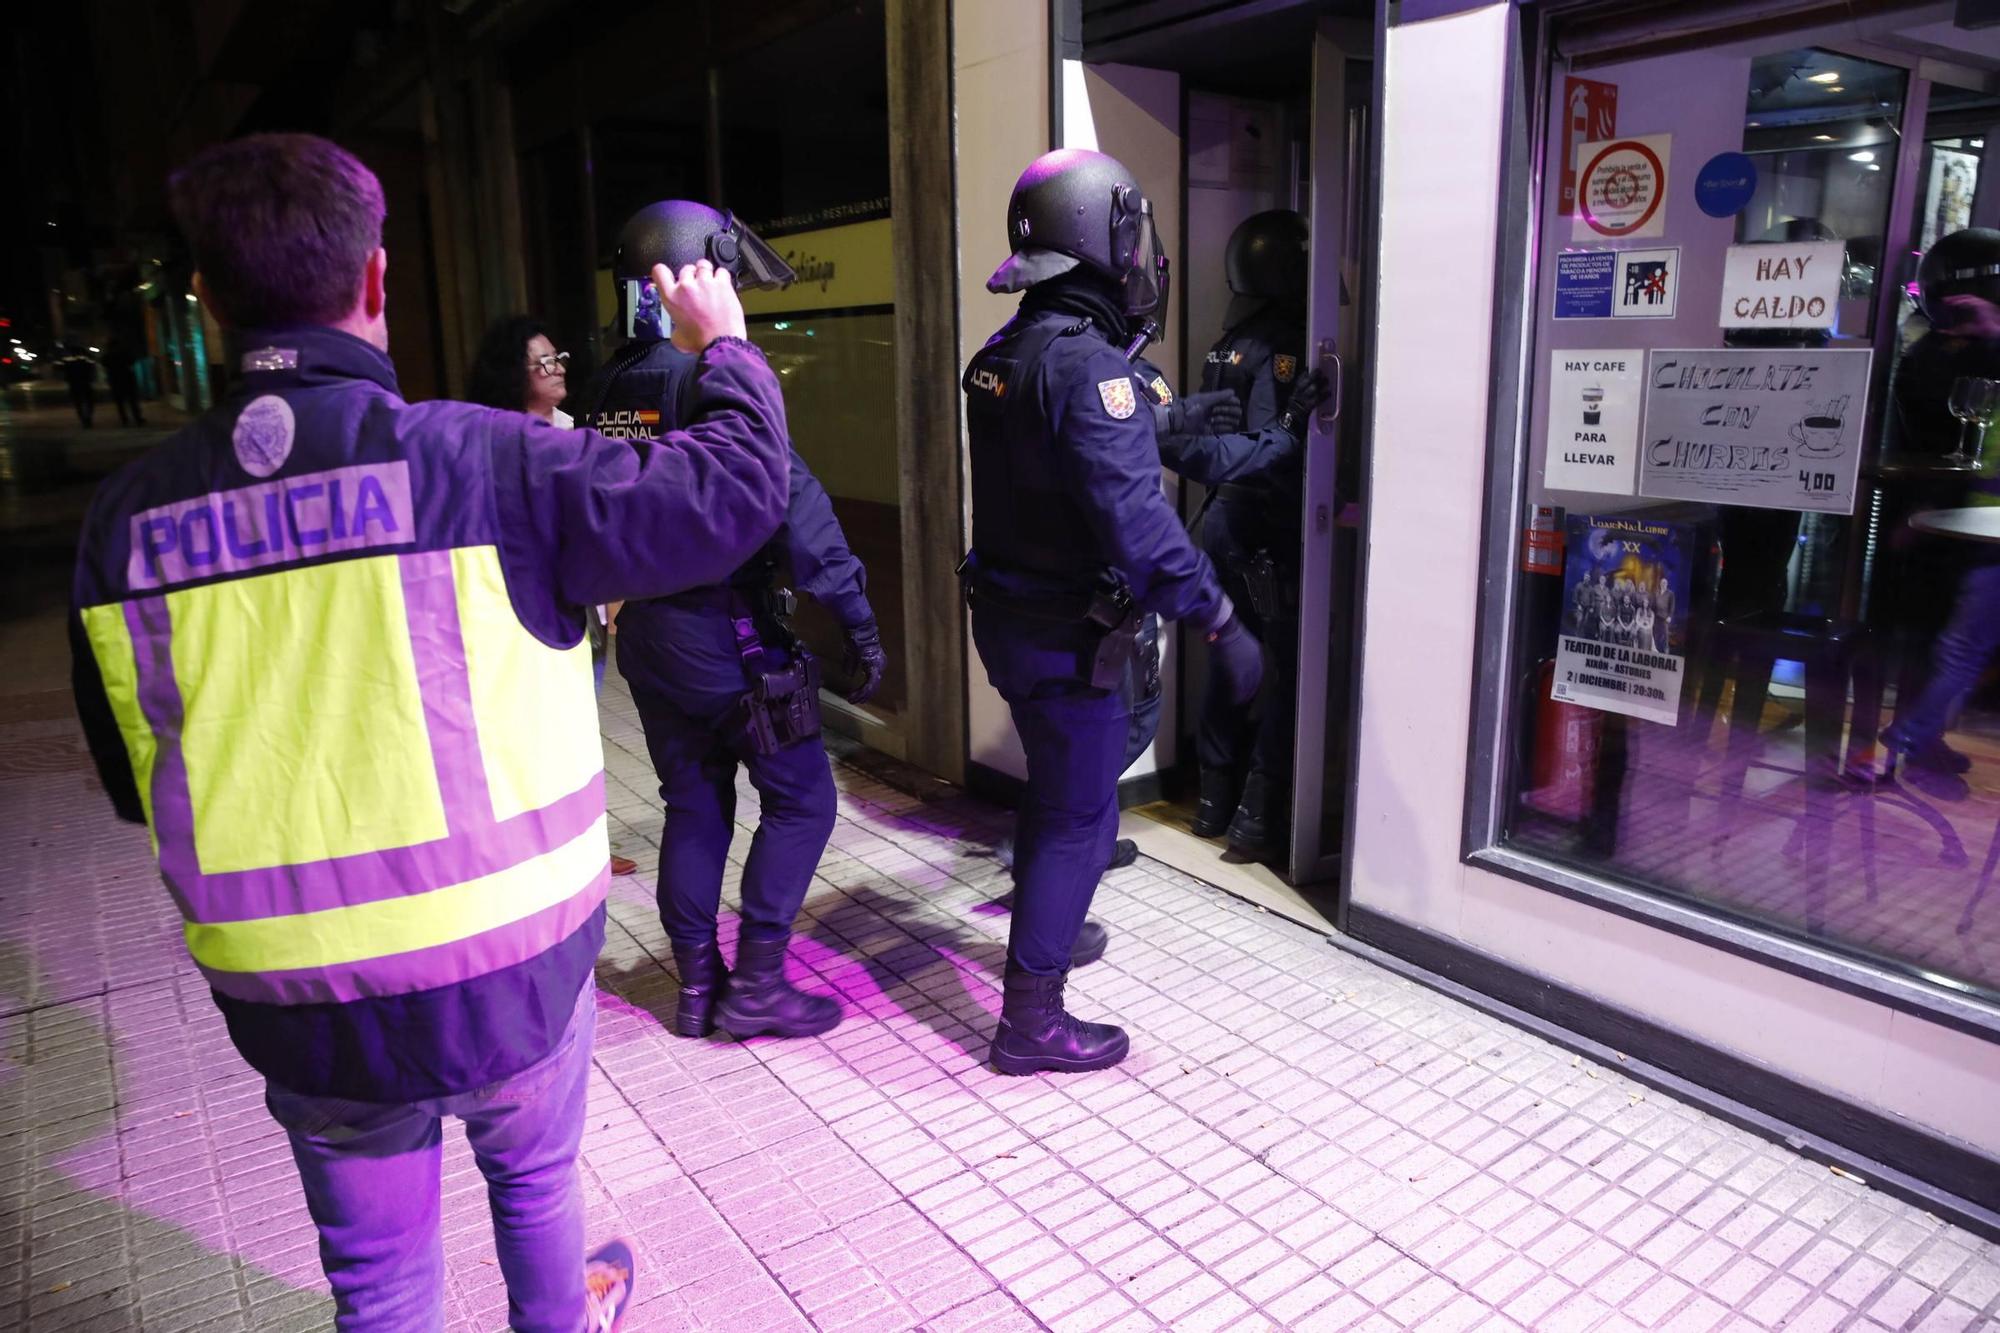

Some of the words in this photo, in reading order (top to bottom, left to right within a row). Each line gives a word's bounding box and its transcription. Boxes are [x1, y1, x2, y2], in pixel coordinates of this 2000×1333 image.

[1756, 254, 1814, 282] HAY
[1734, 295, 1826, 320] CALDO
[1565, 361, 1590, 372] HAY
[1593, 361, 1626, 372] CAFE
[1651, 359, 1820, 392] CHOCOLATE
[1699, 400, 1760, 430] CON
[1574, 432, 1607, 444] PARA
[1563, 452, 1615, 467] LLEVAR
[1646, 434, 1791, 473] CHURROS
[141, 474, 400, 580] POLICIA
[1622, 540, 1641, 554] XX
[1564, 639, 1602, 657] TEATRO
[1603, 646, 1617, 660] DE
[1618, 648, 1630, 663] LA
[1631, 651, 1678, 673] LABORAL
[1567, 670, 1574, 682] 2
[1579, 672, 1628, 693] DICIEMBRE
[1614, 663, 1652, 681] ASTURIES
